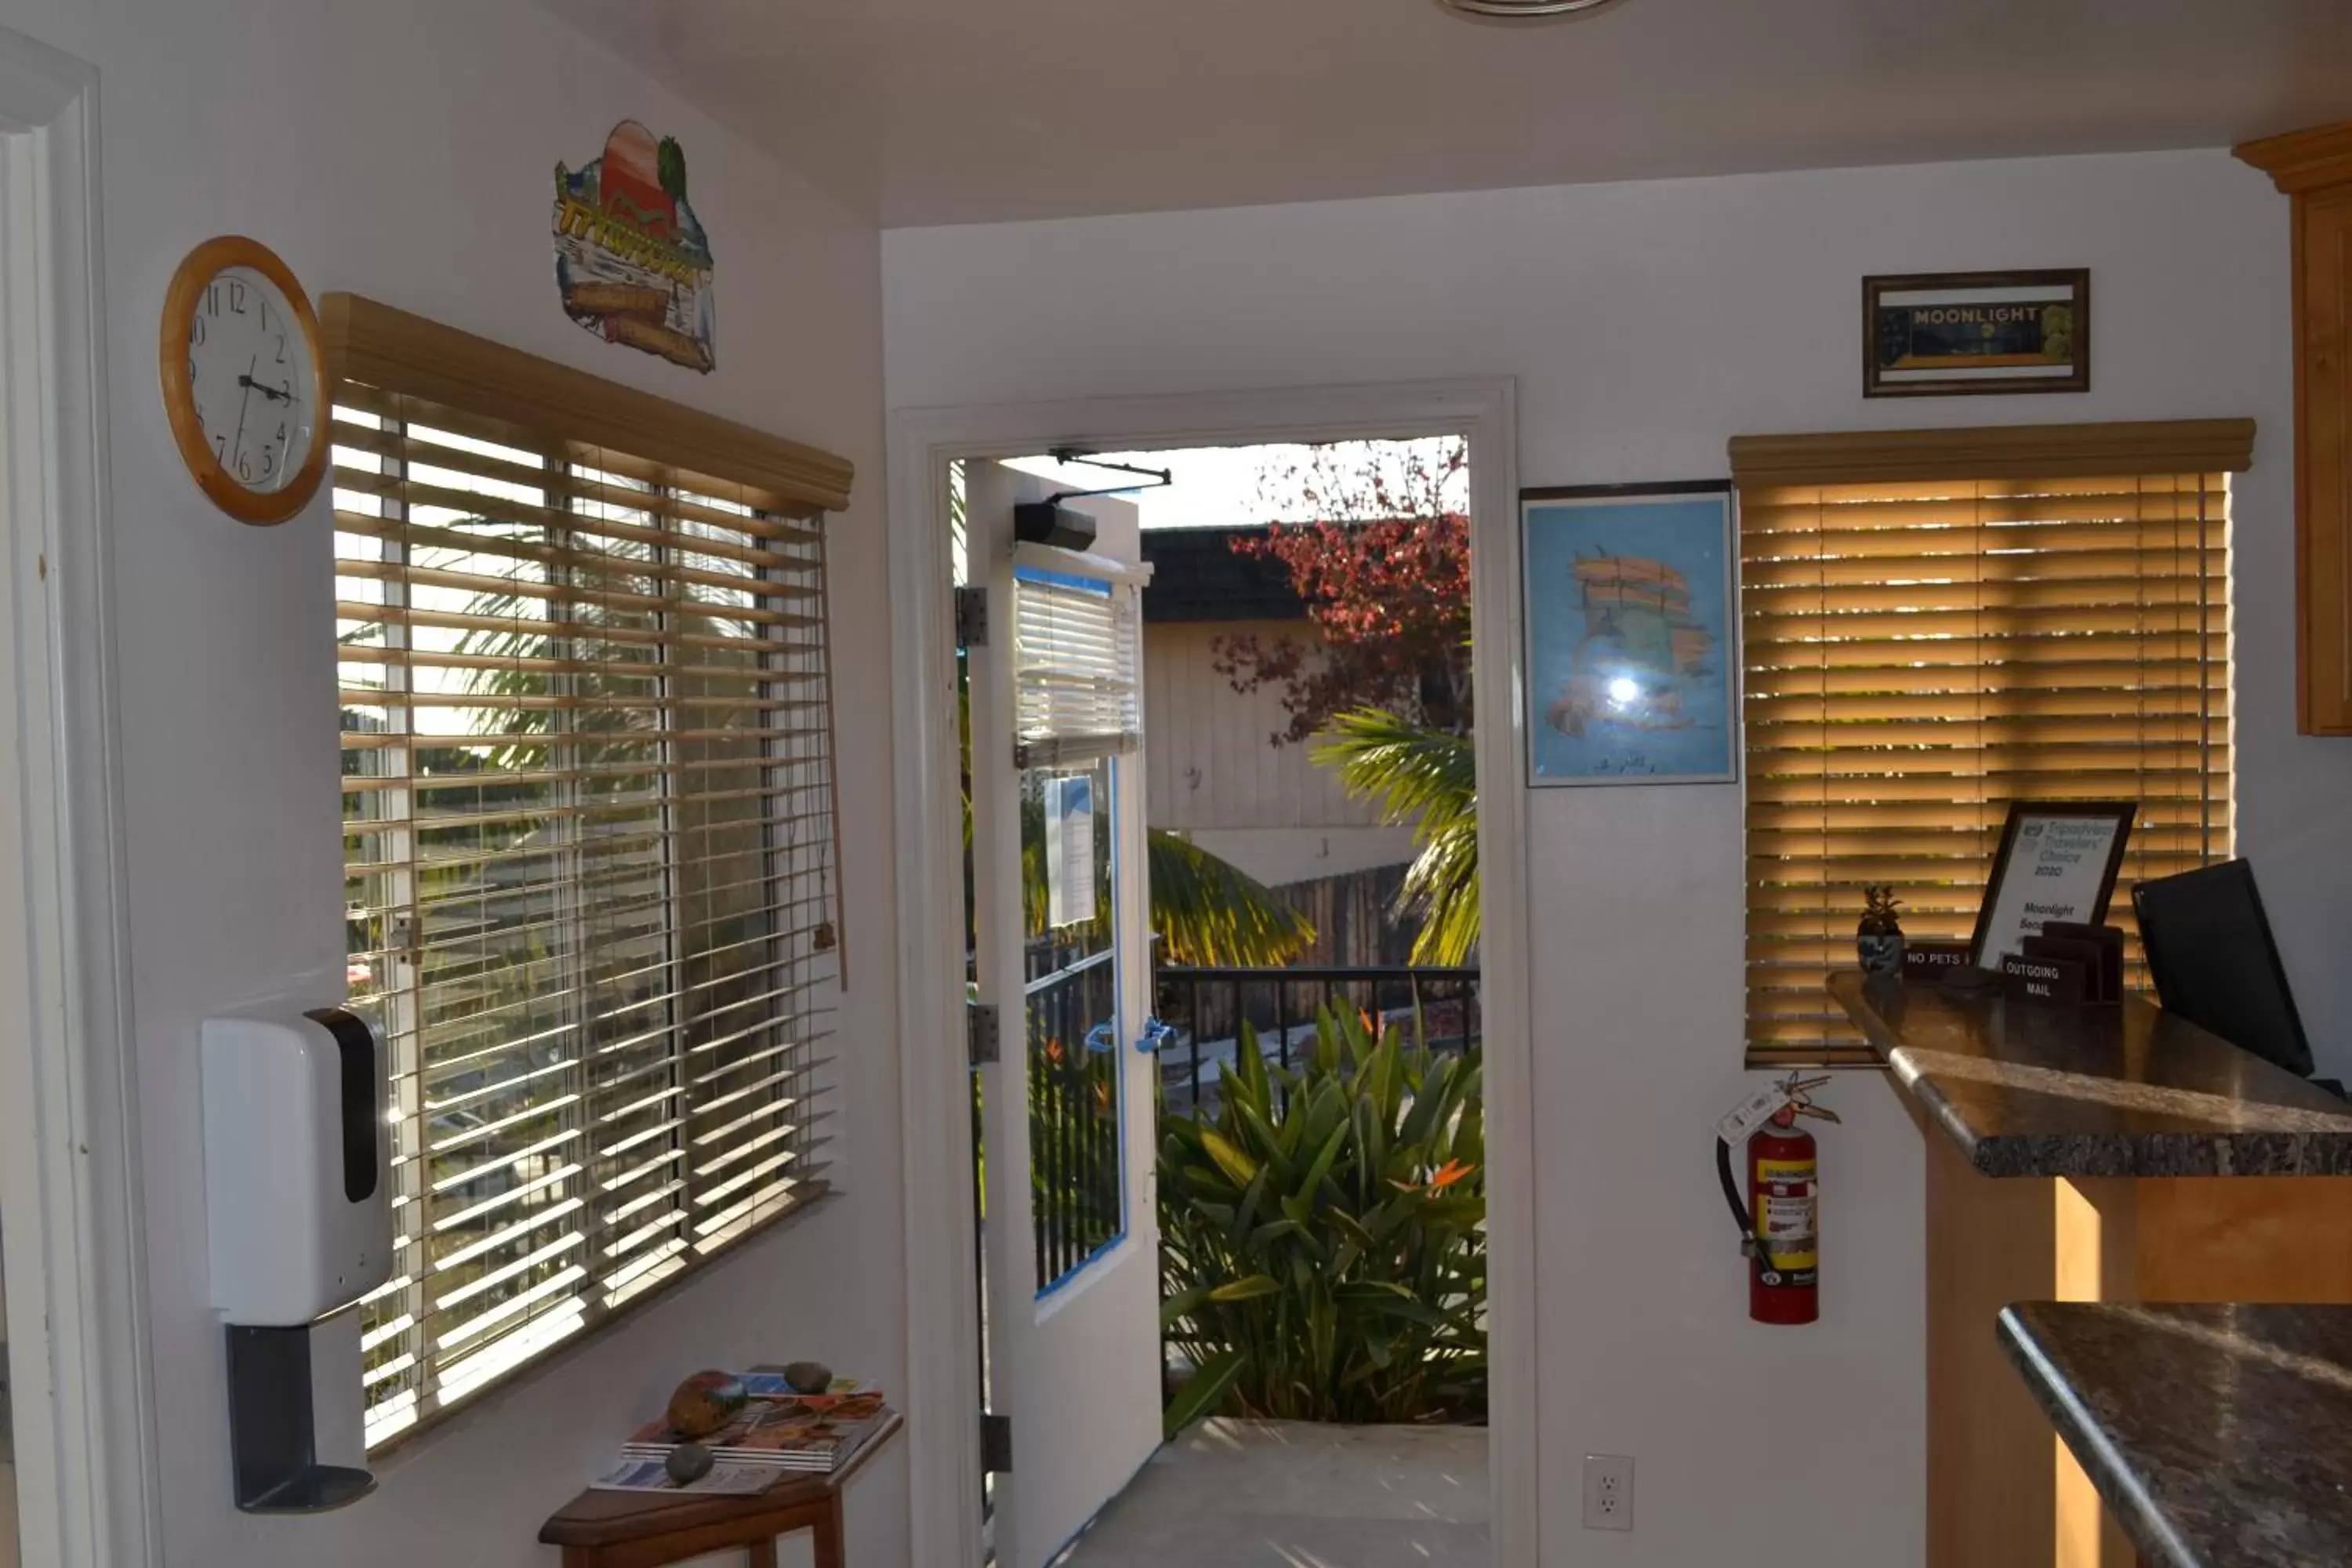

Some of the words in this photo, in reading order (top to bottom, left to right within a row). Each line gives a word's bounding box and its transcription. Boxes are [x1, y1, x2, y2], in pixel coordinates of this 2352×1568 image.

[209, 284, 219, 317] 11
[230, 282, 245, 314] 12
[1916, 307, 2038, 324] MOONLIGHT
[276, 335, 285, 364] 2
[282, 379, 291, 408] 3
[276, 421, 285, 445] 4
[216, 435, 226, 464] 7
[263, 445, 273, 474] 5
[239, 452, 251, 481] 6
[2034, 866, 2063, 877] 2020
[2024, 902, 2074, 917] Moonlight
[1907, 953, 1925, 964] NO
[1929, 953, 1960, 965] PETS
[2006, 962, 2060, 979] OUTGOING
[2027, 982, 2051, 996] MAIL
